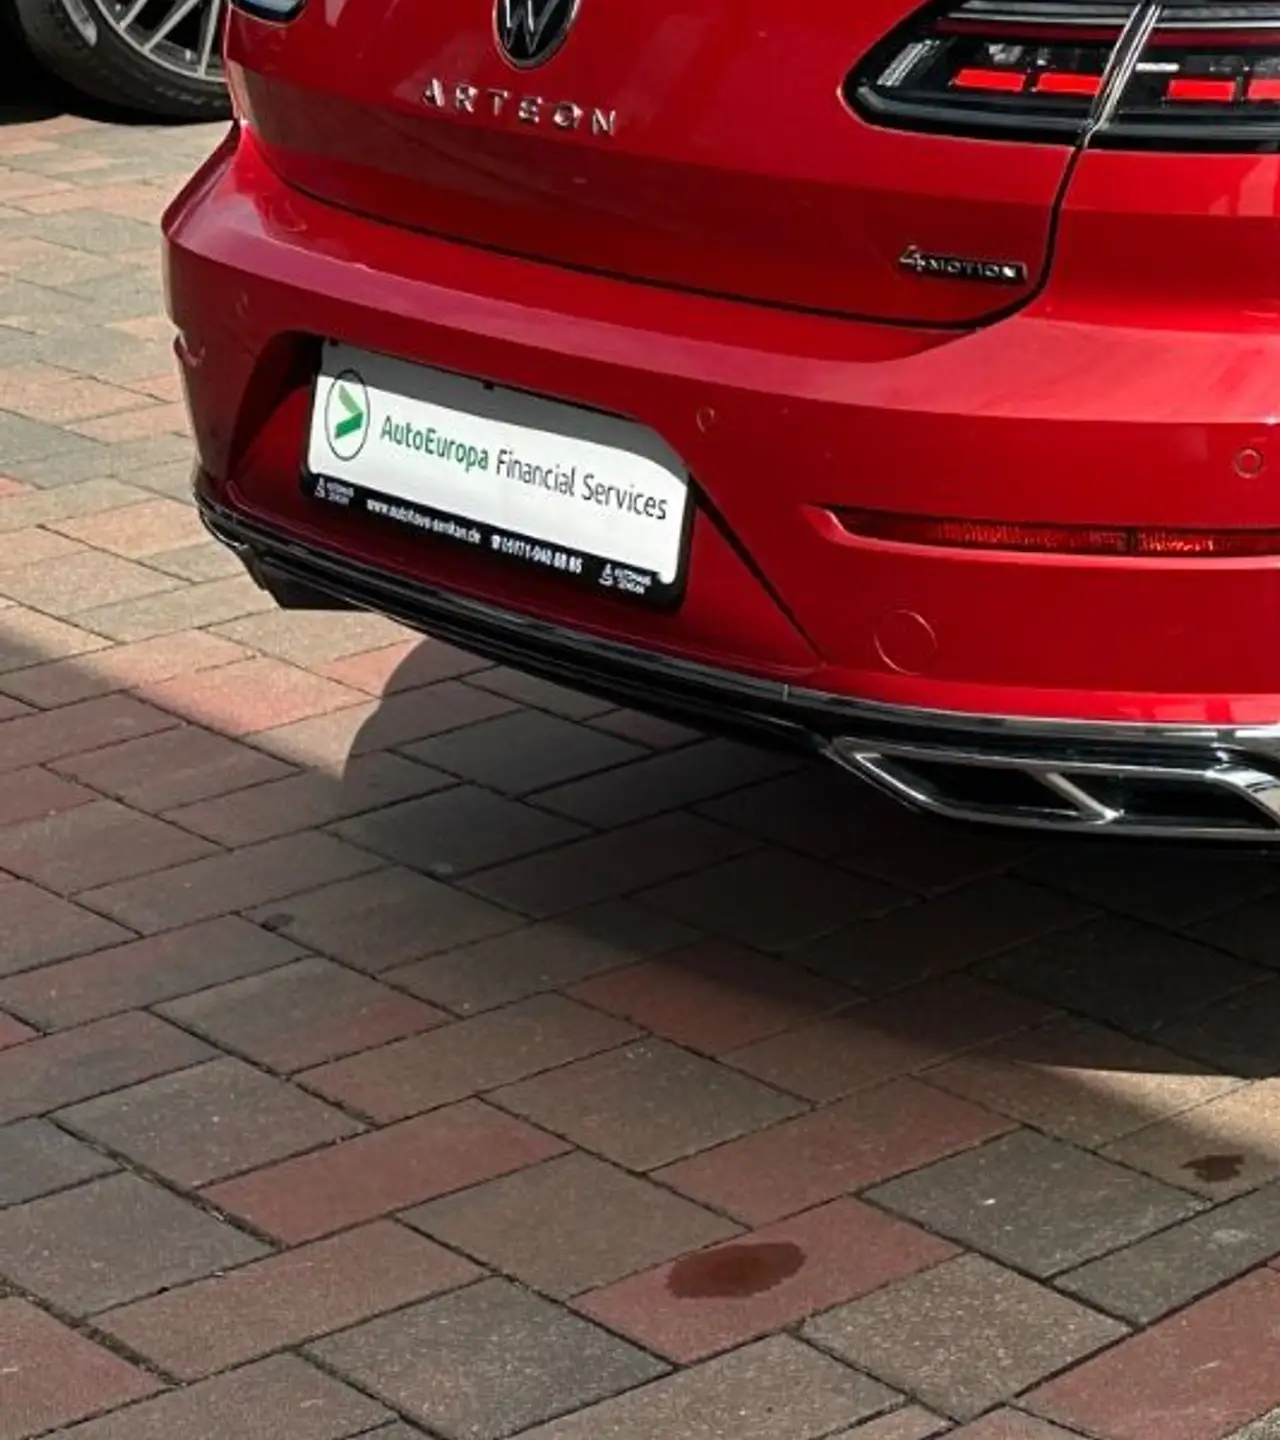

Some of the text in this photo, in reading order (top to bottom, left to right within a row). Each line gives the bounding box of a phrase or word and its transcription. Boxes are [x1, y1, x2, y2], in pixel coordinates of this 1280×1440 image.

[422, 77, 617, 137] ARTEON
[899, 244, 1017, 279] 4MOTION
[380, 415, 669, 521] AutoEuropa Financial Services
